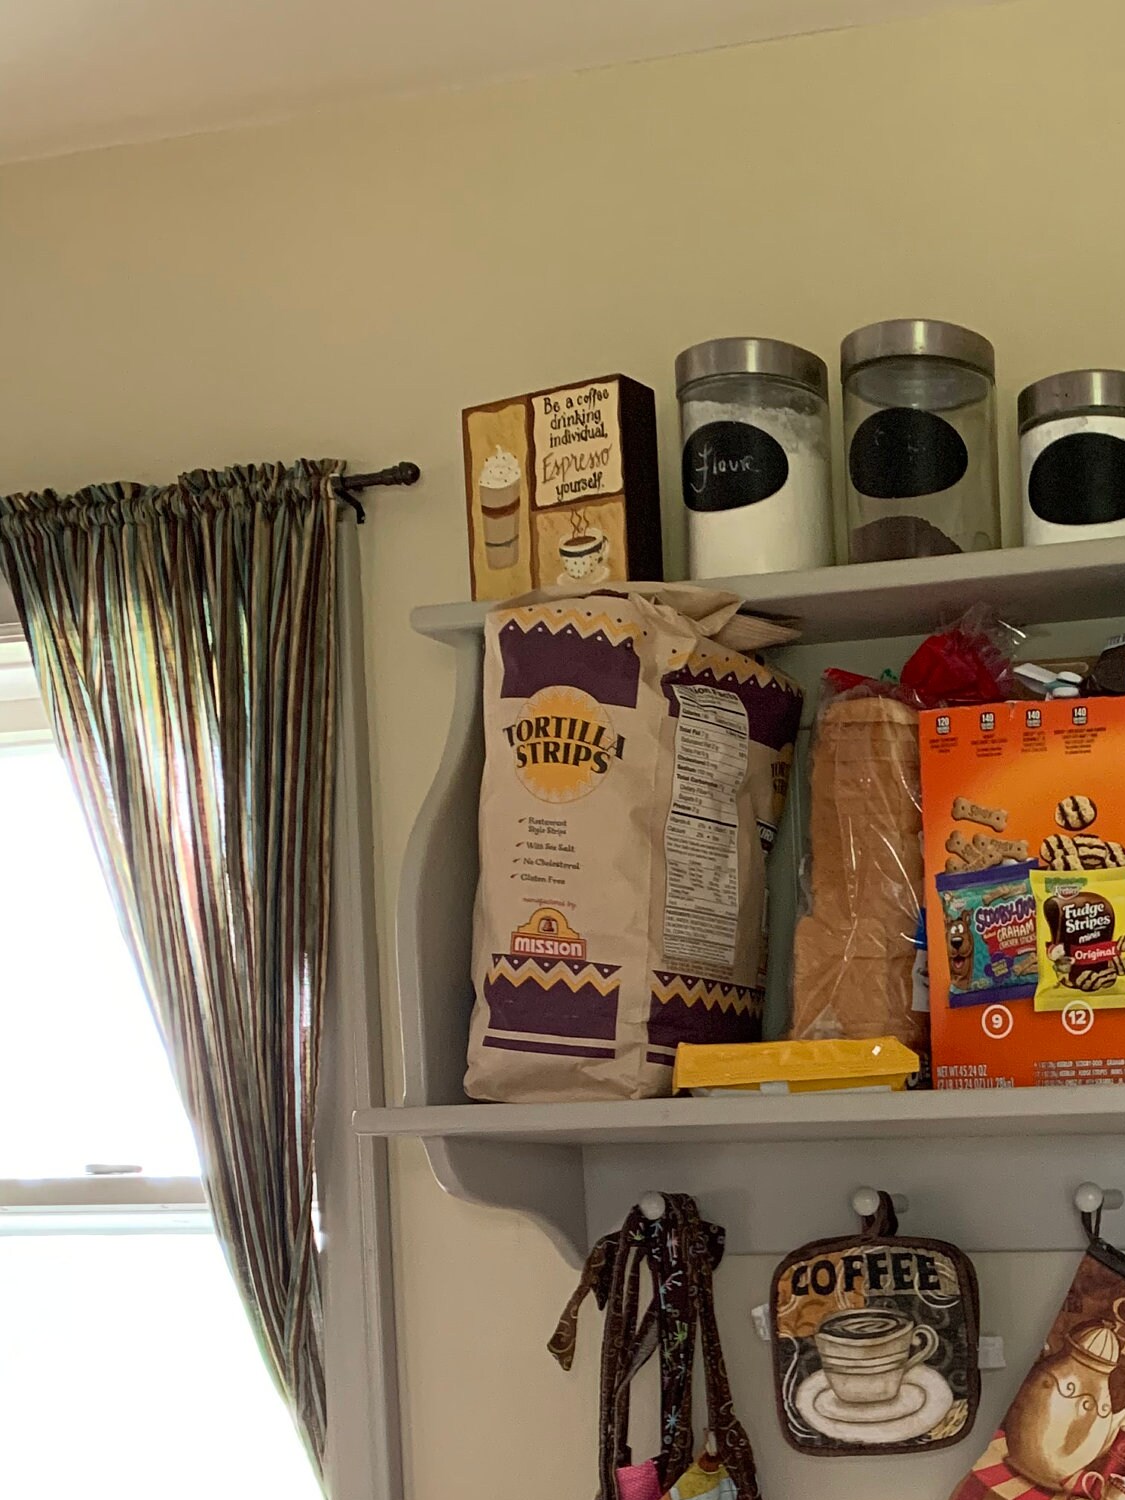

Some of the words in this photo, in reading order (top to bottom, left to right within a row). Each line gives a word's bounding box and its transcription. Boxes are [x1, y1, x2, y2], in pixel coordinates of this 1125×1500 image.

[543, 396, 560, 415] Be
[565, 396, 574, 409] a
[576, 387, 609, 410] coffee
[550, 409, 602, 430] drinking
[549, 421, 608, 449] individual,
[541, 443, 613, 484] Espresso
[555, 471, 605, 502] yourself.
[982, 713, 994, 723] 140
[1027, 710, 1040, 720] 140
[1074, 707, 1086, 717] 140
[502, 715, 626, 760] TORTILLA
[516, 741, 610, 774] STRIPS
[523, 857, 534, 865] No
[520, 873, 546, 883] Gluten
[548, 875, 566, 885] Free
[1063, 903, 1105, 919] Fudge
[997, 919, 1035, 942] GRAHAM
[1065, 915, 1111, 933] Stripes
[1079, 931, 1101, 944] minis
[1074, 946, 1116, 961] Original
[992, 1013, 1003, 1030] 9
[1068, 1010, 1087, 1026] 12
[791, 1252, 941, 1296] COFFEE
